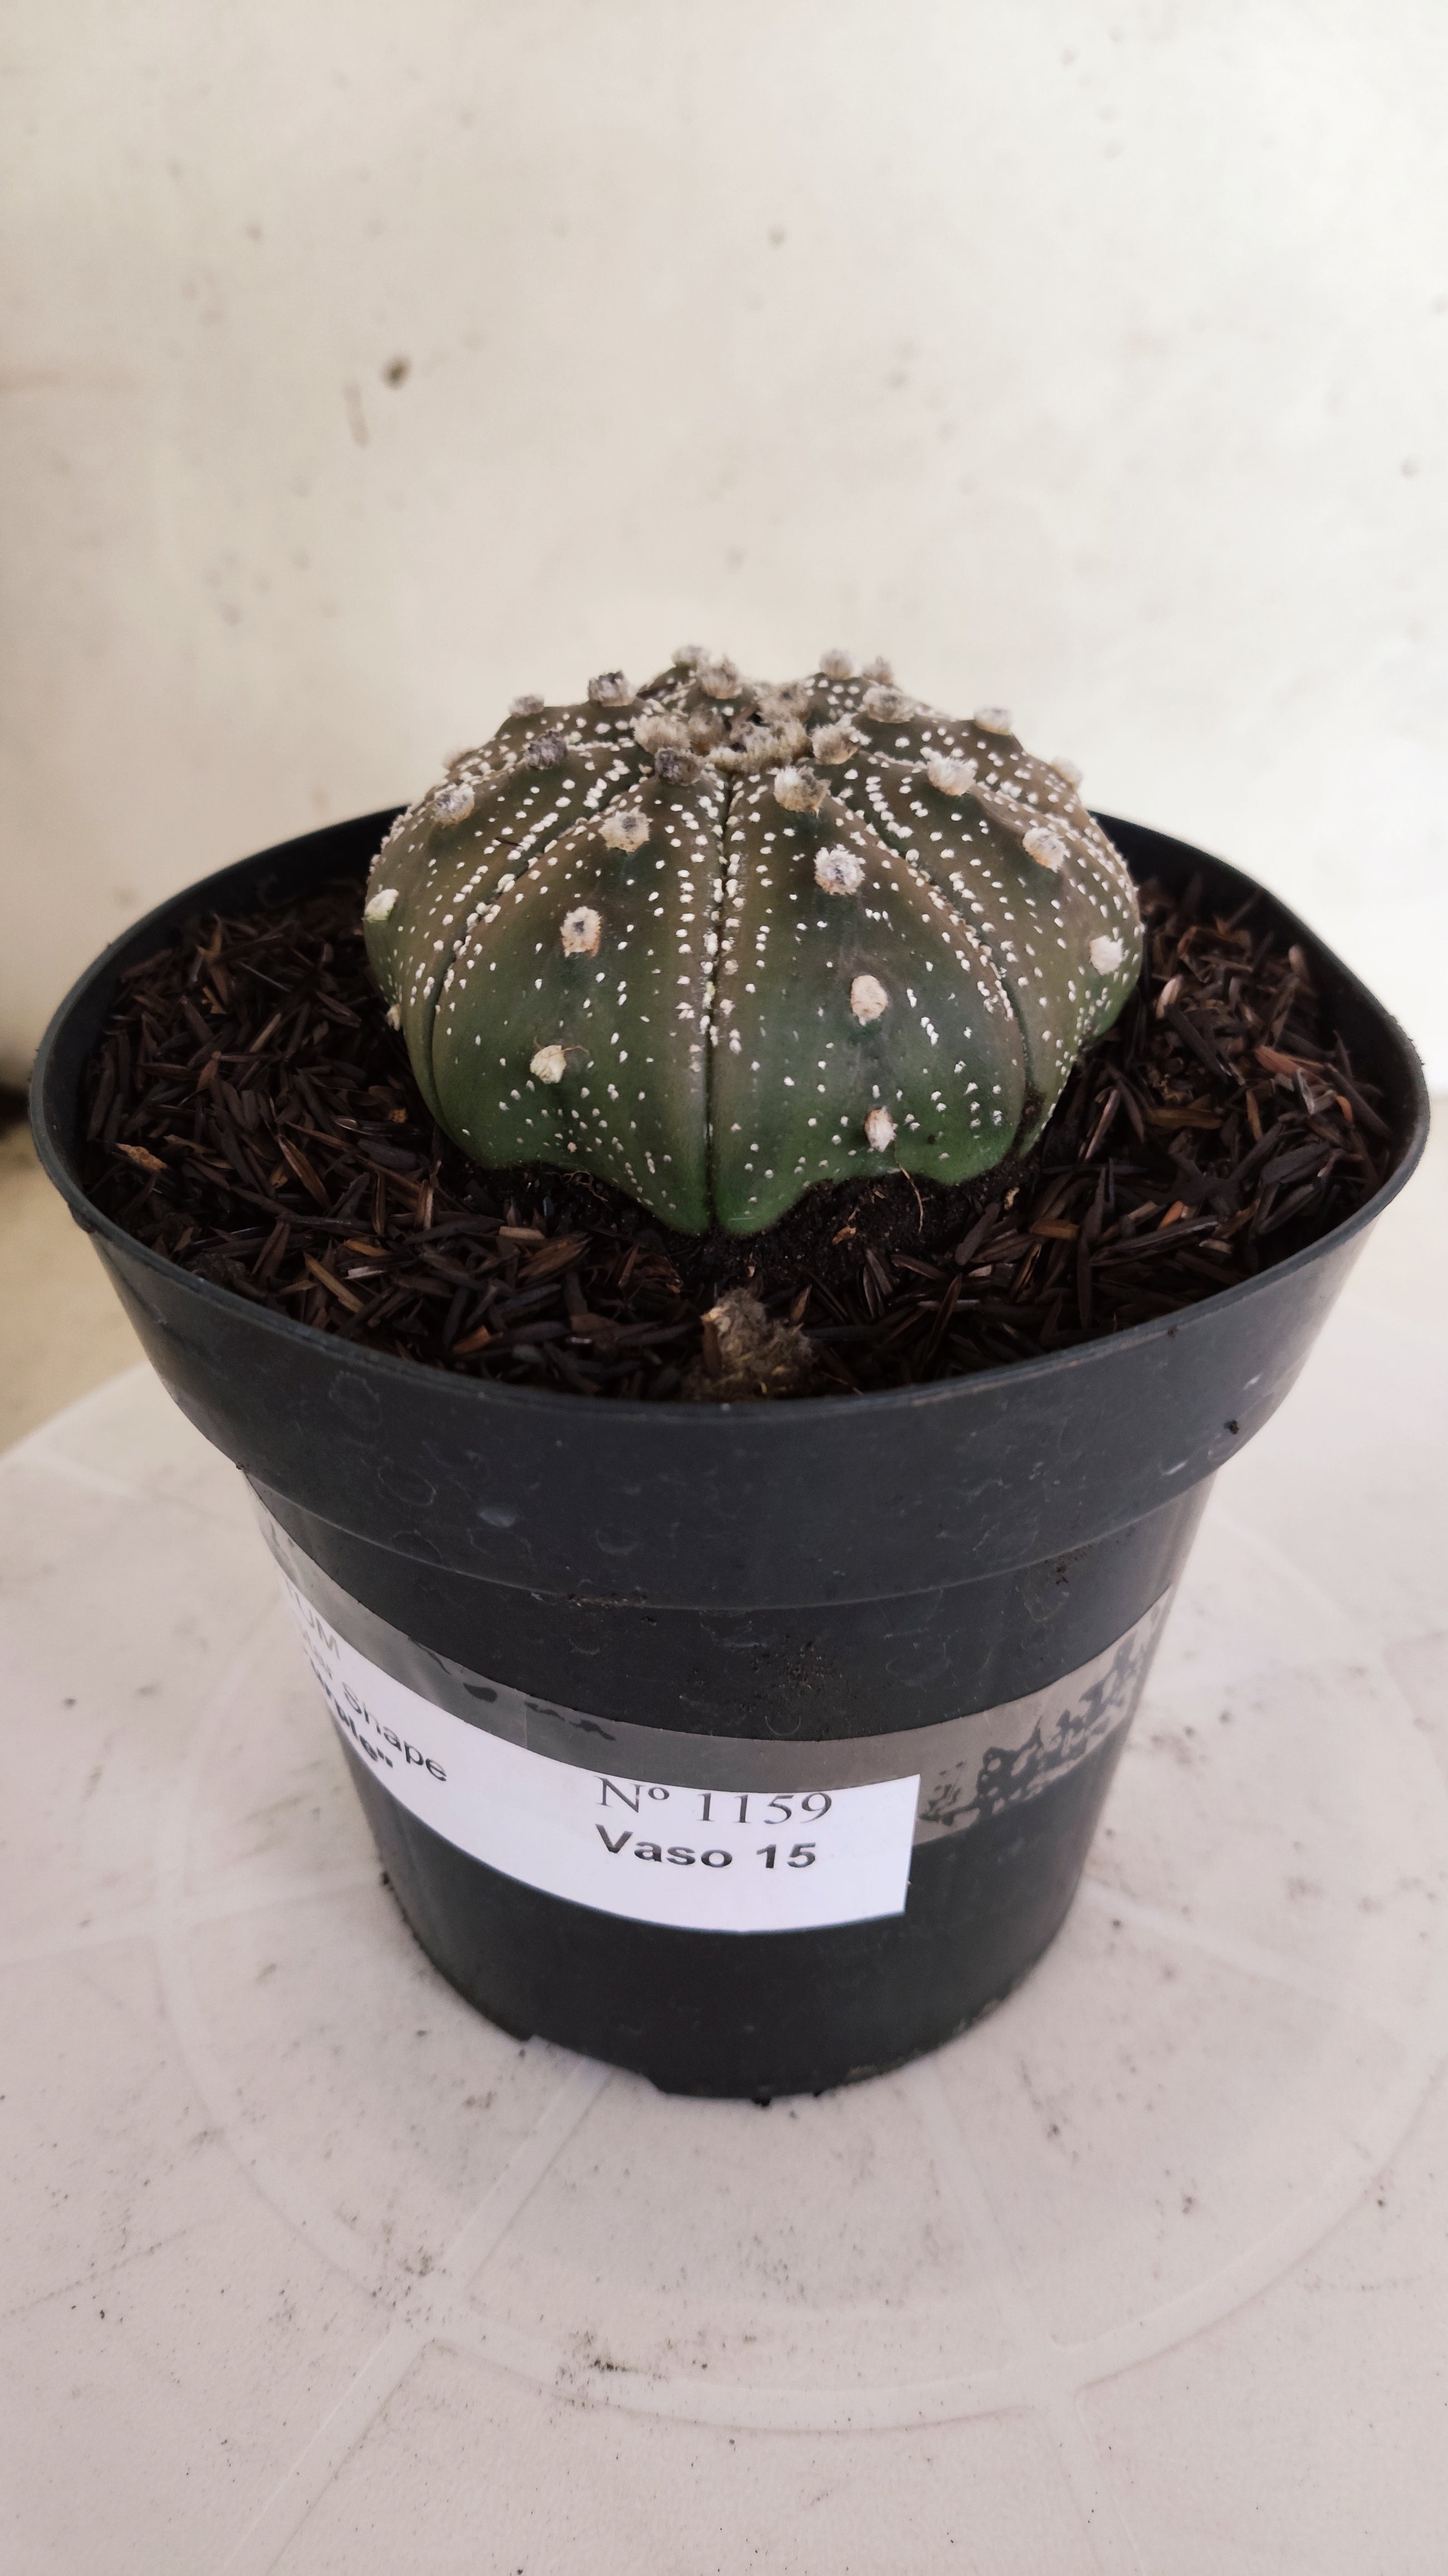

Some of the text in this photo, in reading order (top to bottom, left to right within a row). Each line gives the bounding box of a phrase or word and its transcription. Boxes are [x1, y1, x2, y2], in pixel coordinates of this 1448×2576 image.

[341, 1681, 448, 1783] Shape
[696, 1792, 832, 1824] 1159
[595, 1823, 816, 1868] Vaso 15
